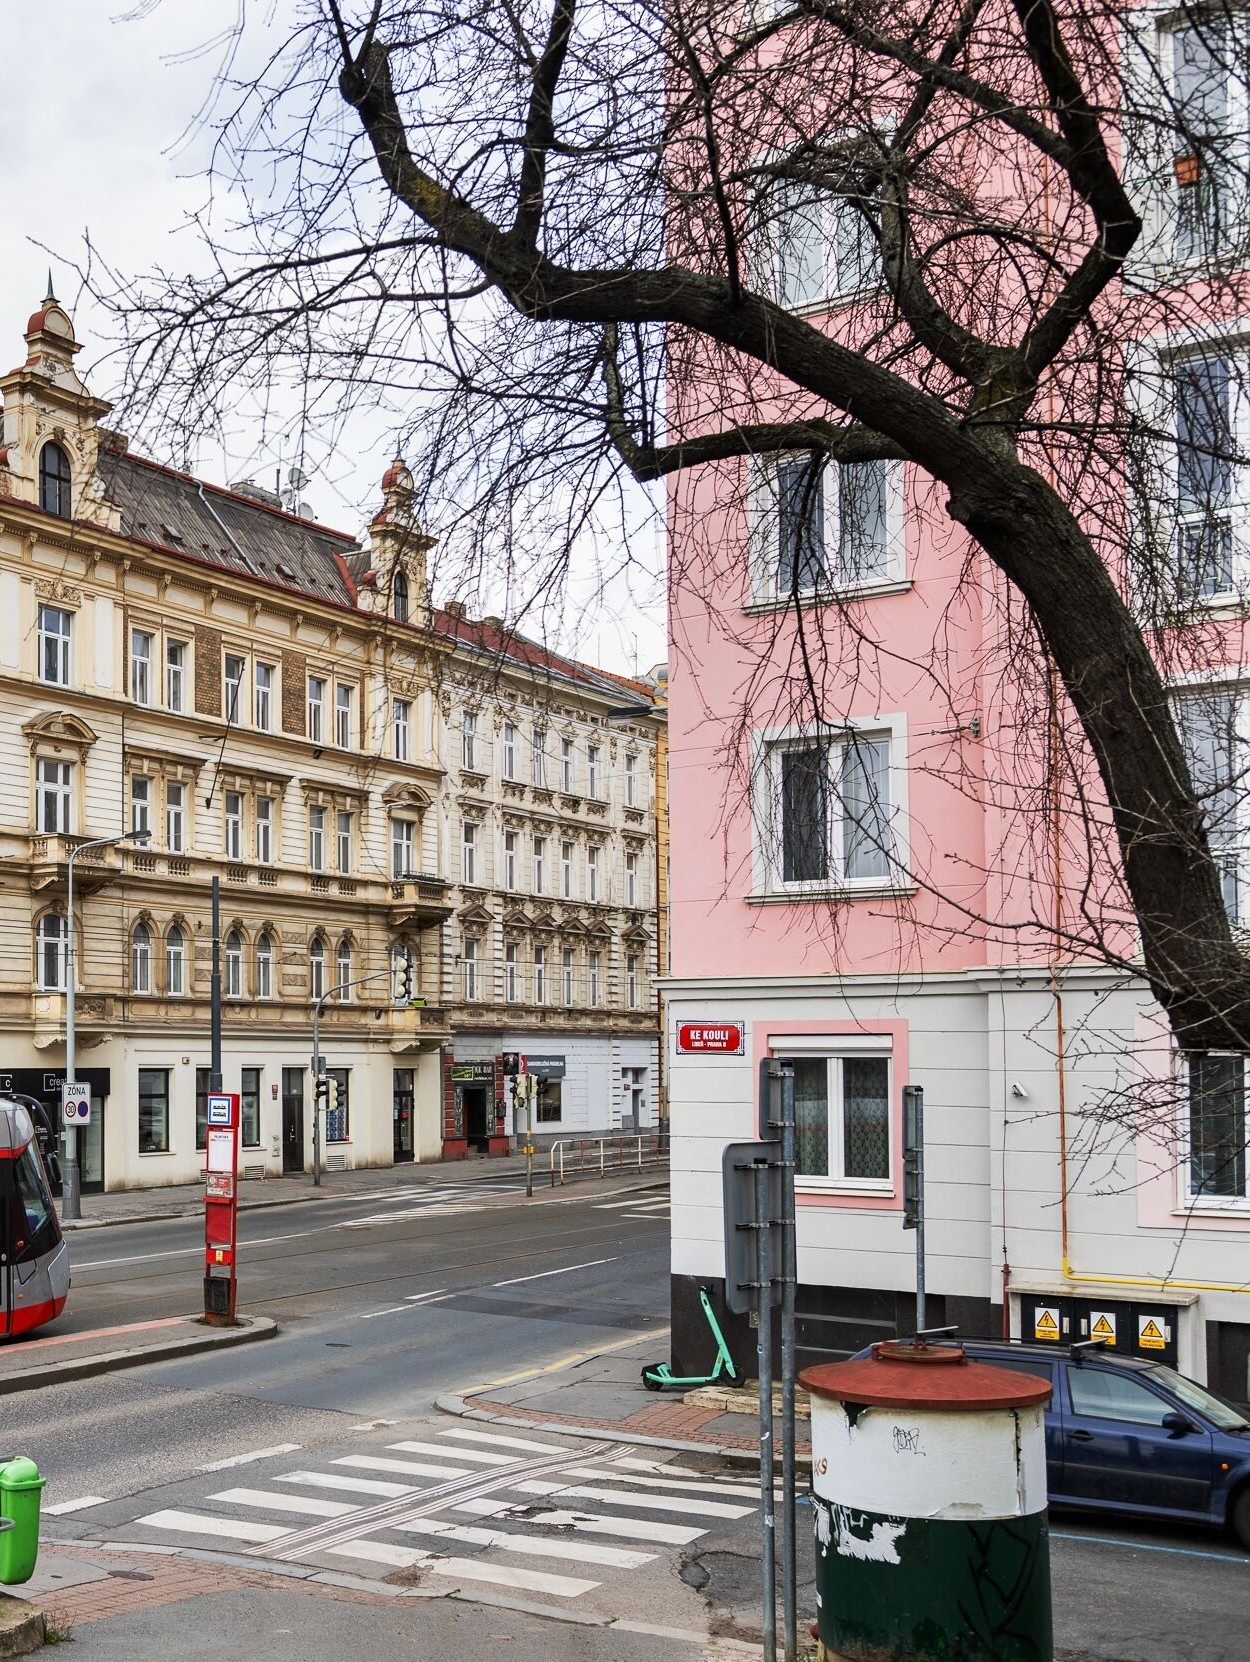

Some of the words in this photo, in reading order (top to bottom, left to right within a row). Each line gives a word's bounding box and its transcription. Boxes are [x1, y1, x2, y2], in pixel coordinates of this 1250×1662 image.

[690, 1030, 701, 1040] KE
[703, 1030, 729, 1040] KOULI
[67, 1085, 86, 1096] ZÓNA
[67, 1105, 75, 1114] 30
